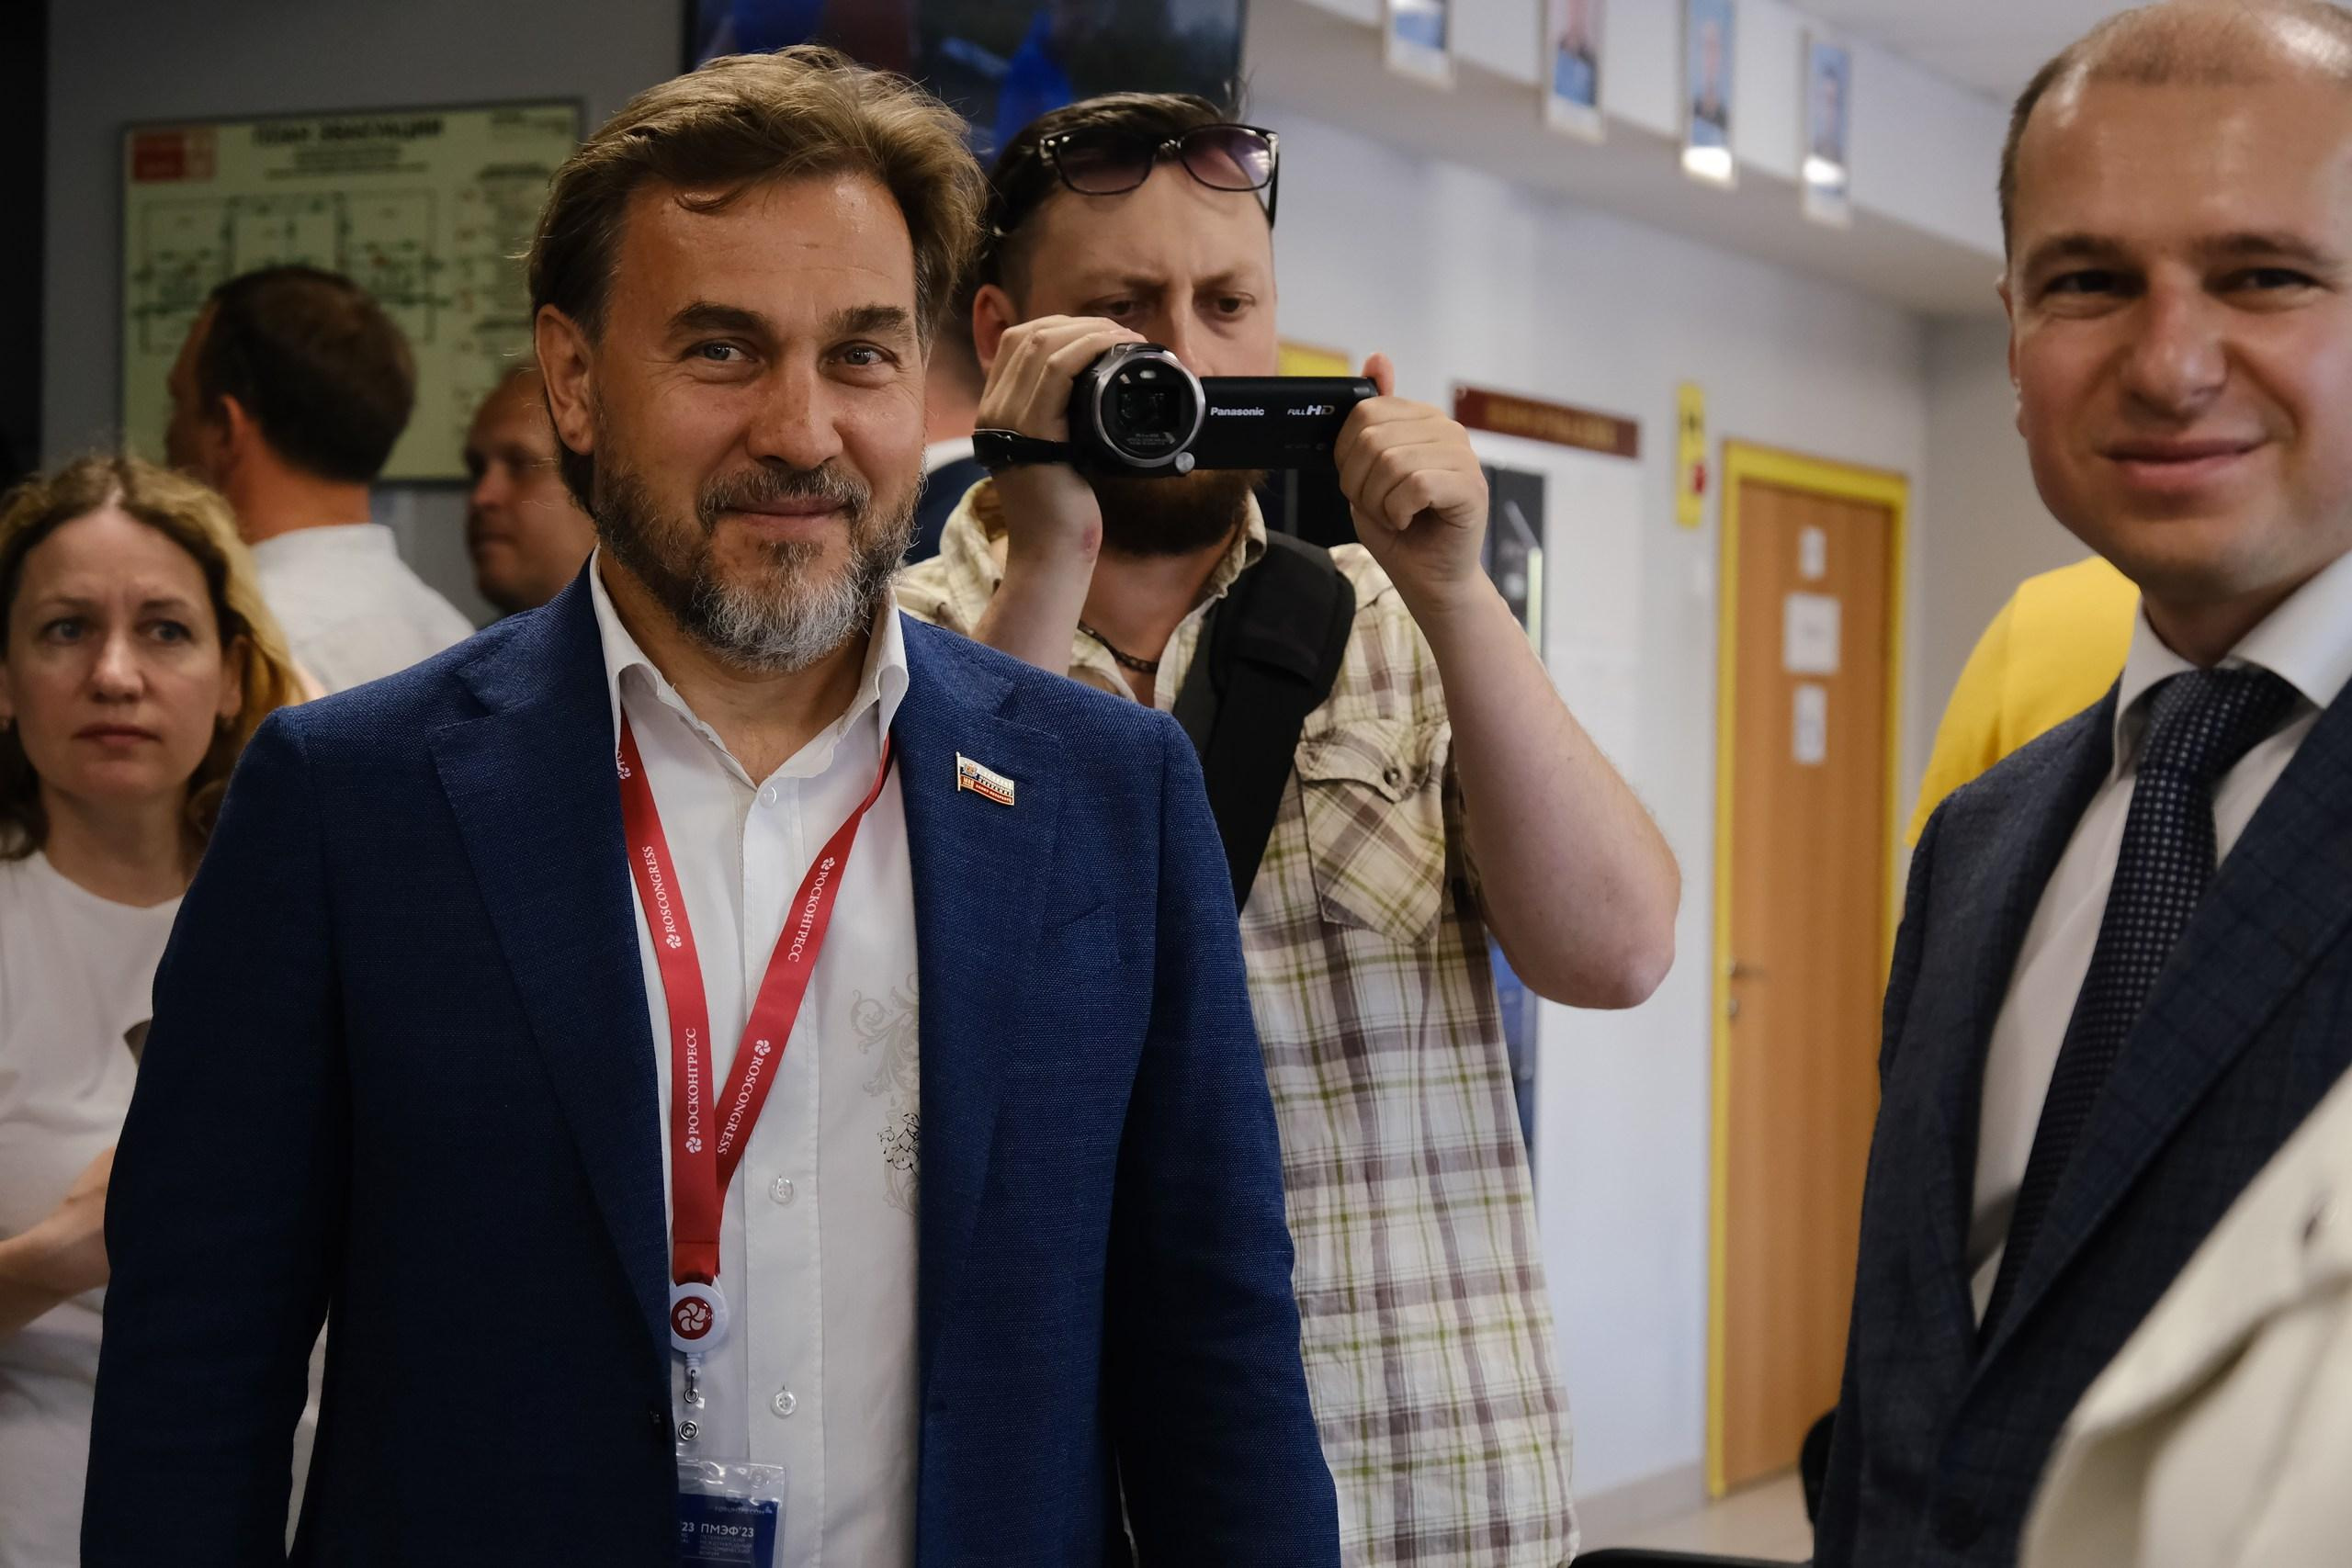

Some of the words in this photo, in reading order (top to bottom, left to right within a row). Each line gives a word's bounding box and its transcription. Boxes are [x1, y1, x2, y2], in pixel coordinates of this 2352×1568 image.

[1210, 406, 1265, 416] Panasonic
[1287, 408, 1306, 416] FULL
[1306, 405, 1336, 416] HD
[641, 845, 676, 934] ROSCONGRESS
[787, 869, 829, 963] РОСКОНГРЕСС
[685, 1027, 699, 1135] РОСКОНГРЕСС
[717, 1055, 763, 1155] ROSCONGRESS
[700, 1523, 754, 1538] ПМЭФ'23
